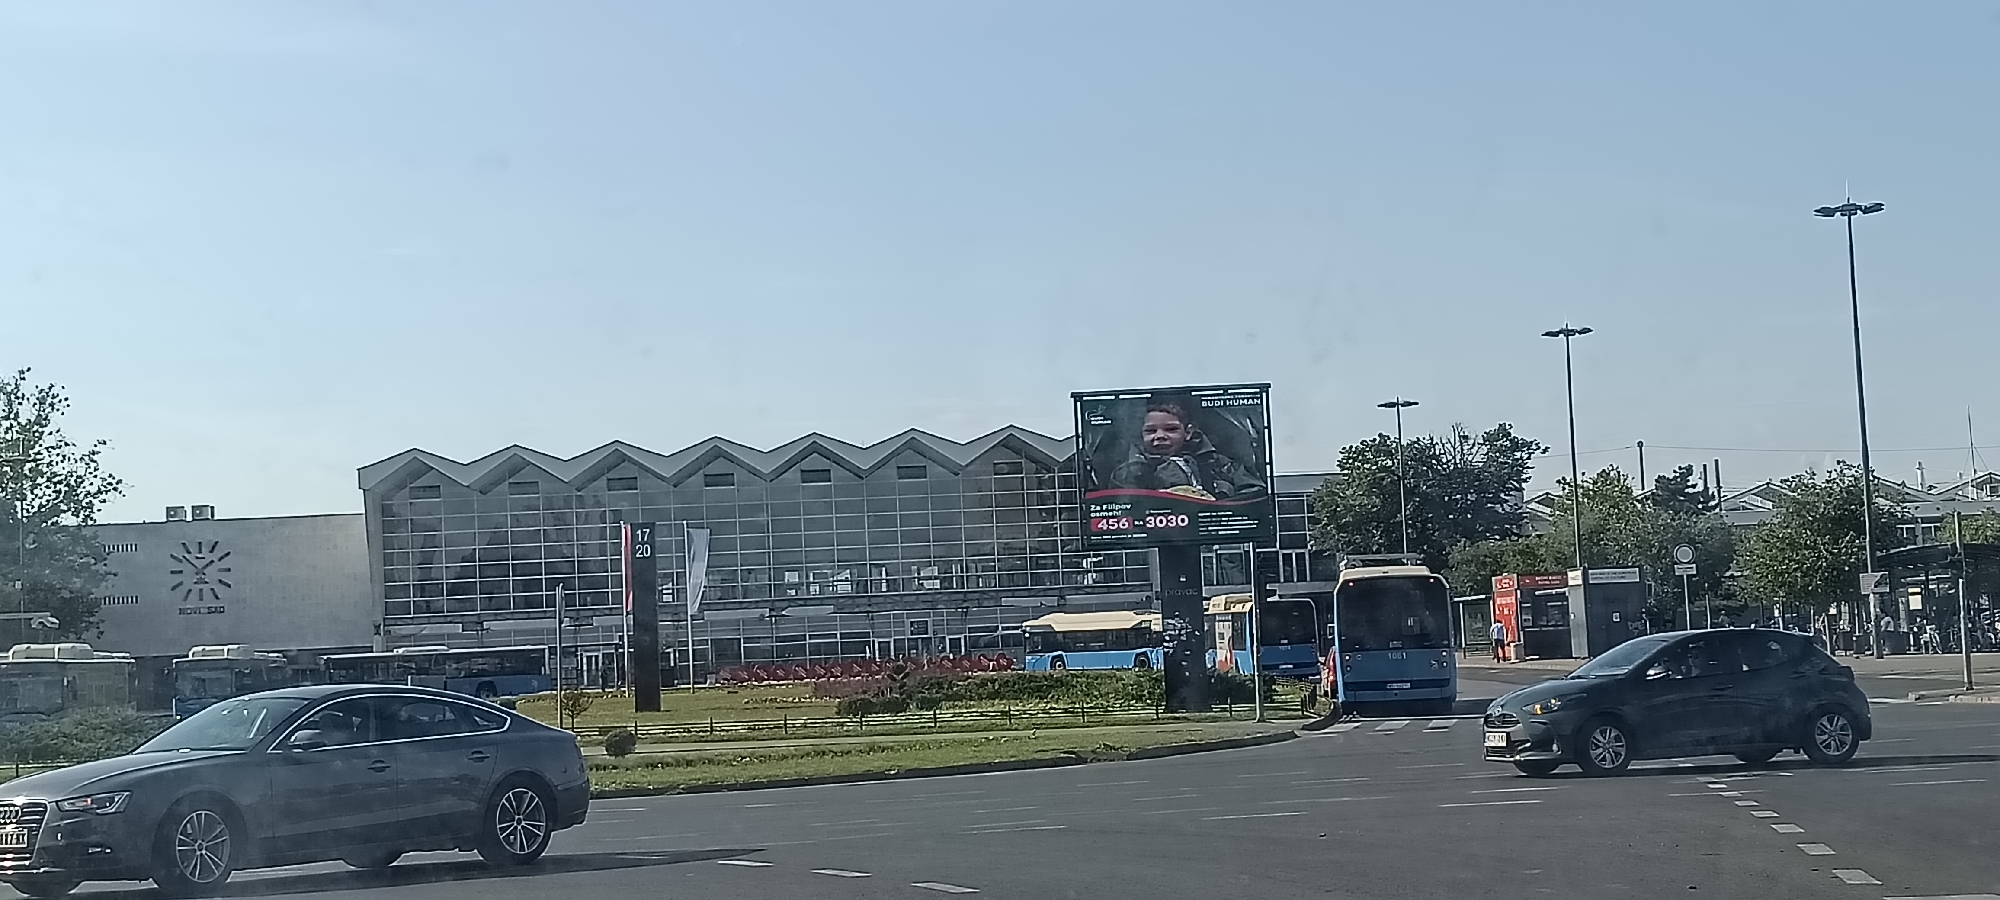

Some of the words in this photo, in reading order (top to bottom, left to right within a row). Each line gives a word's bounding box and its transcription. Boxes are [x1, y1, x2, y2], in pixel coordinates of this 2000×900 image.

[1226, 398, 1261, 406] HUMAN
[1097, 518, 1129, 531] 456
[1145, 515, 1189, 528] 3030
[635, 528, 651, 542] 17
[635, 544, 652, 558] 20
[179, 607, 201, 615] NOVI
